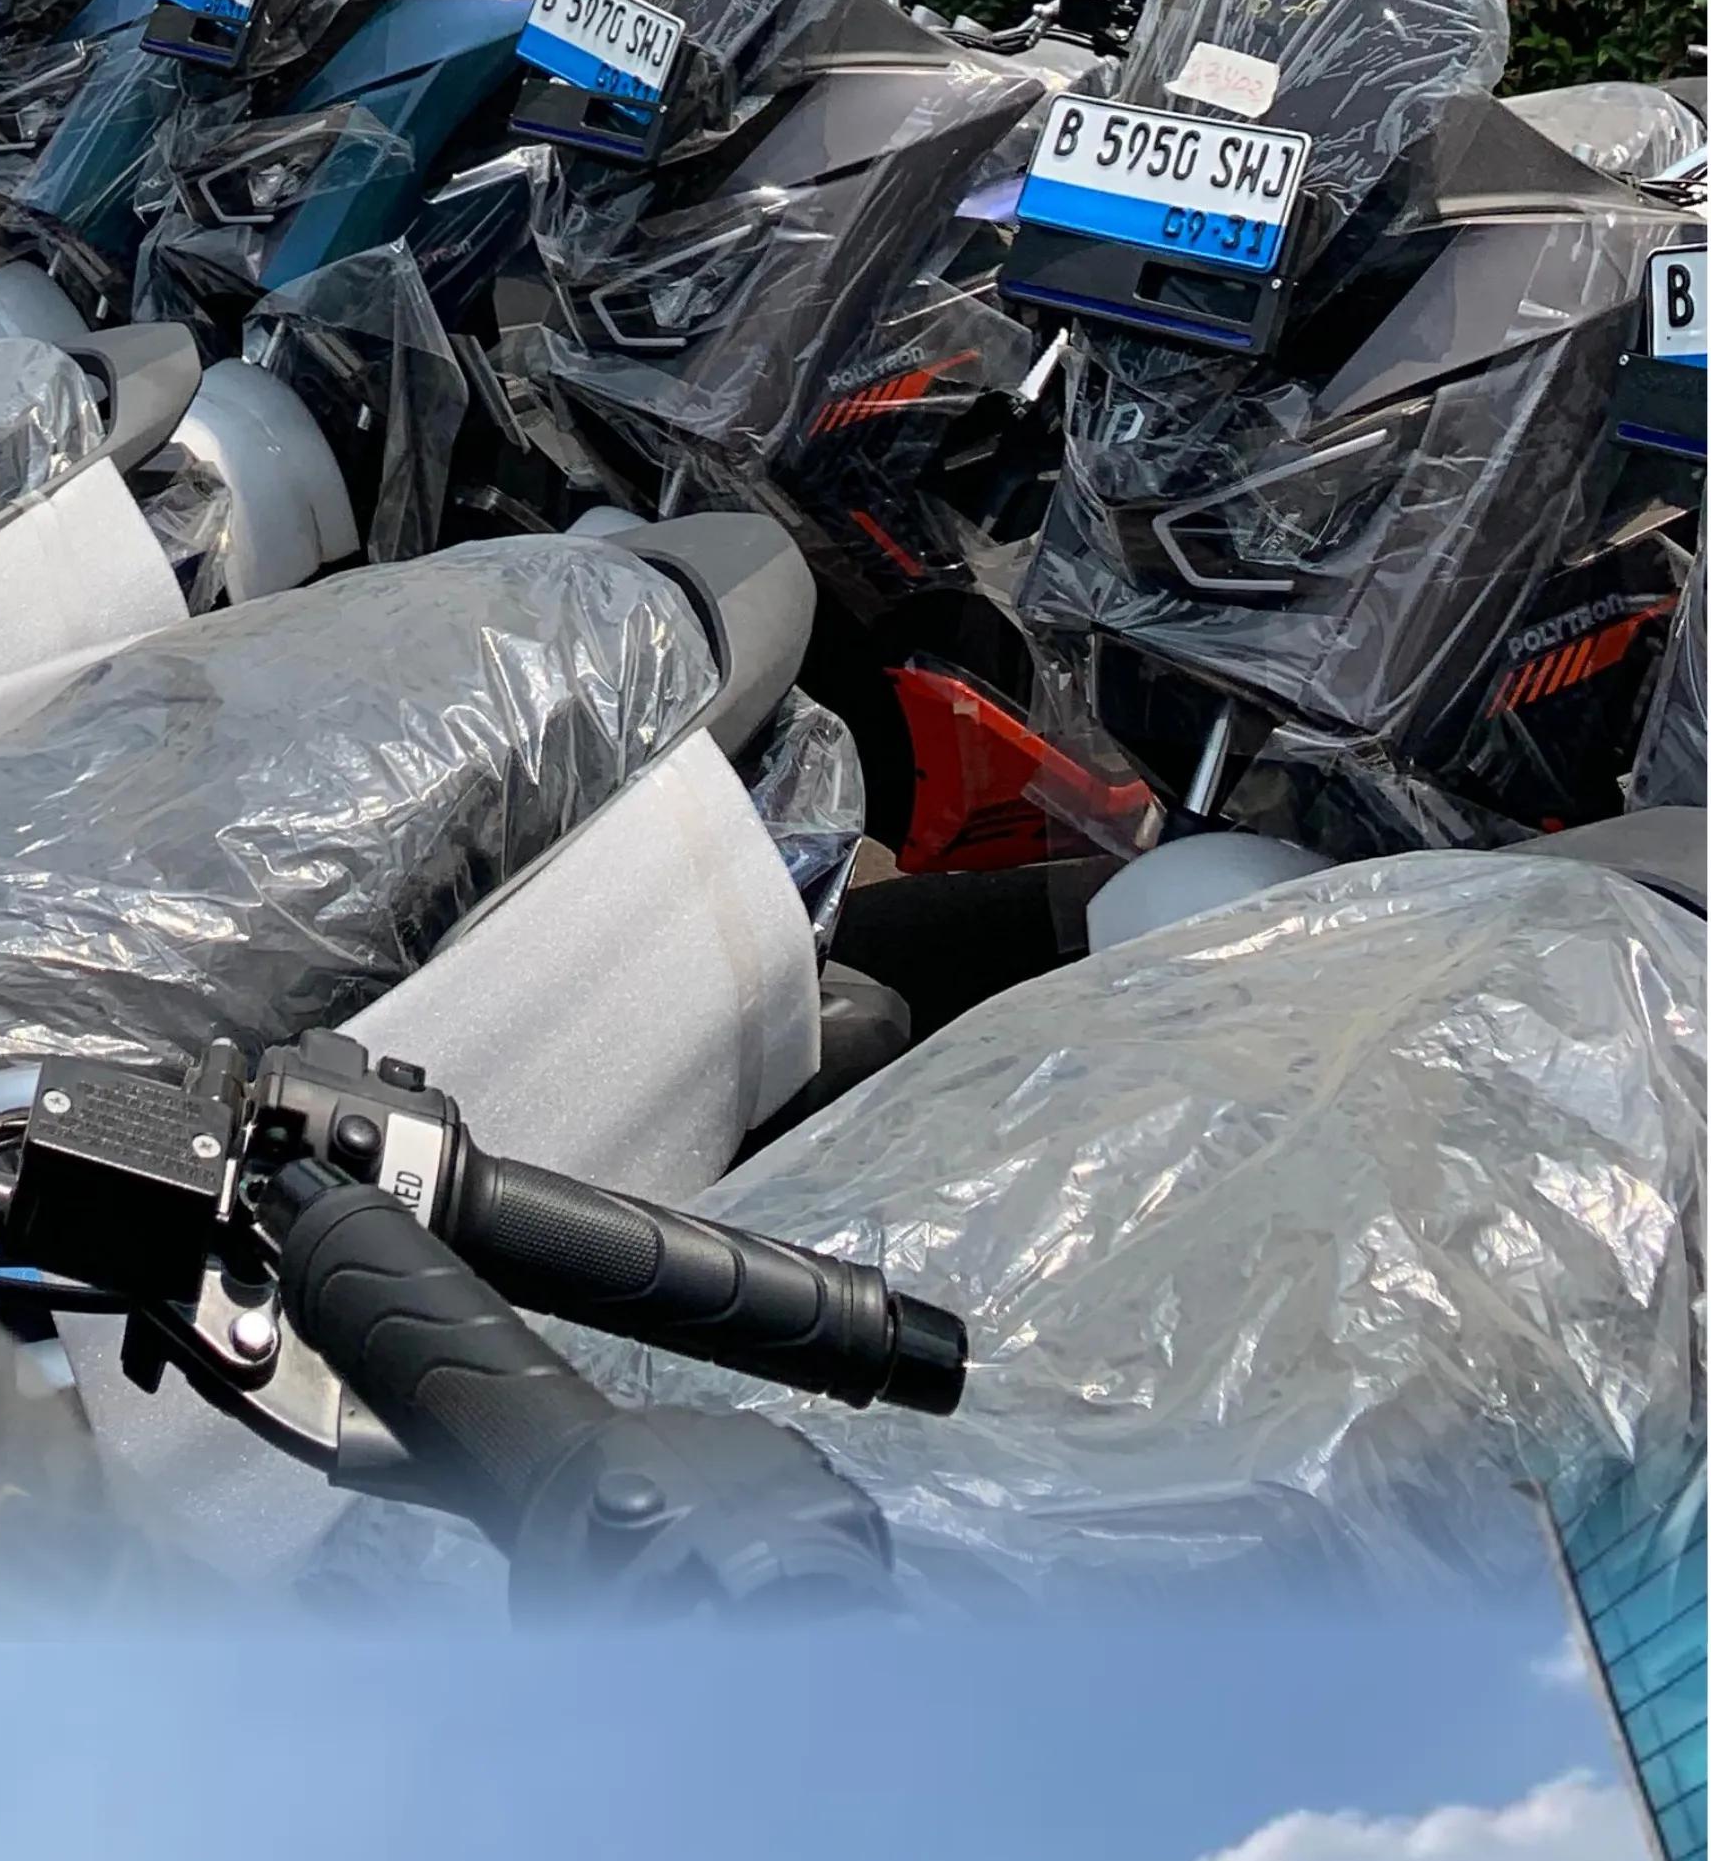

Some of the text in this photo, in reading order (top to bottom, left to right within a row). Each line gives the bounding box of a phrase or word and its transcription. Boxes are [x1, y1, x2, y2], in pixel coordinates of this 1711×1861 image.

[625, 14, 673, 67] SWJ
[1054, 107, 1294, 198] B 5950 SWJ
[1667, 264, 1695, 328] B
